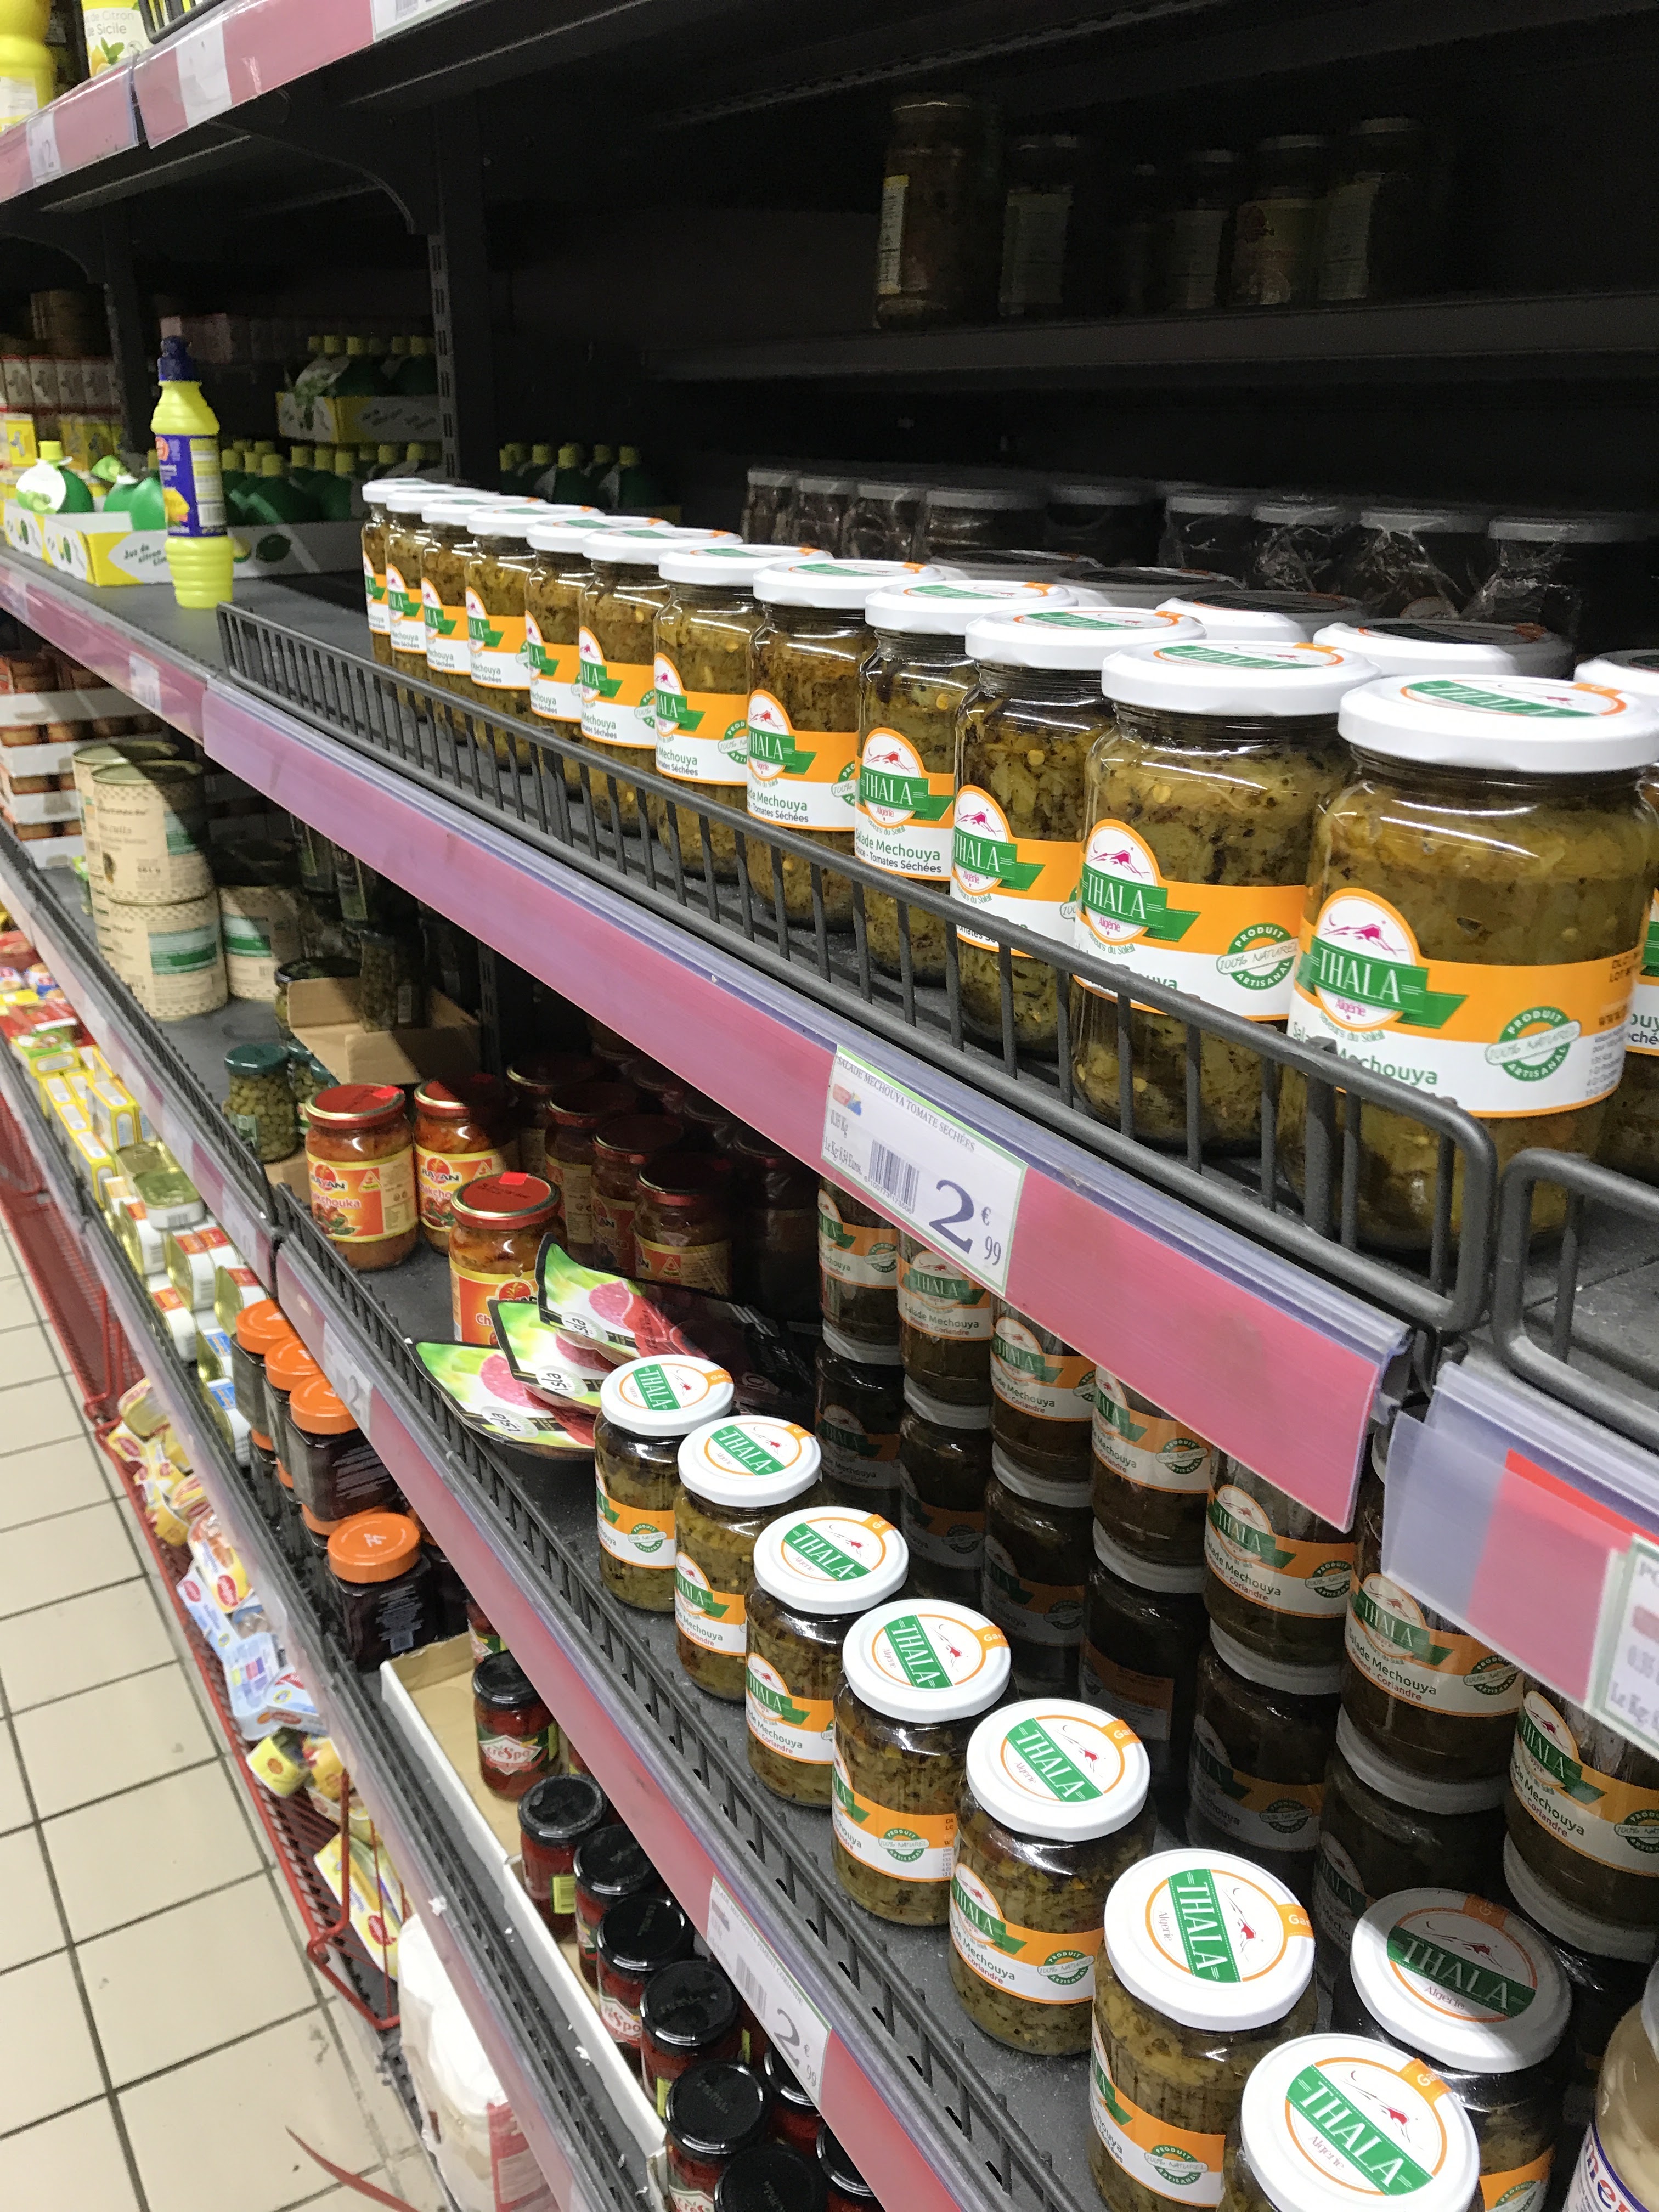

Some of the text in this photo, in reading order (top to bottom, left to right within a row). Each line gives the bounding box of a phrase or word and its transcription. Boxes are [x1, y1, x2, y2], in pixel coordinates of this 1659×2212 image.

[97, 23, 127, 35] Sicile
[102, 10, 134, 21] Citron
[659, 748, 698, 766] Mechouya
[757, 791, 808, 812] Mechouya
[865, 772, 913, 805] THALA
[775, 808, 809, 823] Séchées
[870, 852, 941, 873] Tomates Séchées
[876, 838, 940, 862] Mechouya
[955, 833, 1000, 873] THALA
[1087, 872, 1147, 920] THALA
[1098, 916, 1121, 932] Algérie
[1234, 927, 1284, 949] PRODUIT
[1220, 955, 1248, 970] 100%
[1236, 960, 1290, 988] ARTISANAL
[1319, 947, 1401, 1003] THALA
[1507, 1009, 1562, 1035] PRODUIT
[1508, 1048, 1567, 1079] ARTISANAL
[837, 1056, 864, 1080] SALADE
[864, 1073, 906, 1107] MECHOUYA
[906, 1098, 938, 1128] TOMATE
[421, 1168, 459, 1181] RAYAN
[929, 1179, 1002, 1266] 2 € 99
[917, 1274, 958, 1296] THALA
[929, 1314, 979, 1329] Mechouya
[934, 1325, 969, 1337] Coriandre
[638, 1369, 673, 1408] THALA
[1006, 1383, 1056, 1408] Mechouya
[1011, 1395, 1046, 1414] Coriandre
[718, 1430, 769, 1474] THALA
[1218, 1507, 1261, 1553] THALA
[791, 1527, 855, 1579] THALA
[1224, 1560, 1282, 1596] Mechouya
[1229, 1576, 1268, 1601] Coriandre
[683, 1616, 724, 1642] Mechouya
[686, 1627, 715, 1647] Coriandre
[1364, 1599, 1413, 1647] THALA
[892, 1623, 941, 1685] THALA
[1372, 1656, 1437, 1696] Mechouya
[1377, 1673, 1423, 1702] Coriandre
[749, 1678, 782, 1713] THALA
[757, 1720, 803, 1750] Mechouya
[761, 1733, 794, 1755] Coriandre
[1521, 1716, 1565, 1780] THALA
[1015, 1729, 1085, 1799] THALA
[1523, 1781, 1585, 1836] Mechouya
[1526, 1802, 1568, 1838] Coriandre
[887, 1829, 916, 1838] PRODUIT
[889, 1849, 923, 1863] ARTISANAL
[955, 1884, 995, 1937] THALA
[1176, 1882, 1228, 1971] THALA
[962, 1940, 1016, 1982] Mechouya
[967, 1955, 1005, 1985] Coriandre
[1048, 1951, 1082, 1963] PRODUIT
[1060, 1957, 1093, 1971] NATUREL
[1049, 1967, 1088, 1986] ARTISANAL
[1403, 1937, 1508, 2010] THALA
[774, 2008, 800, 2068] 2
[806, 2064, 817, 2087] 99
[1300, 2081, 1404, 2188] THALA
[1155, 2146, 1192, 2161] PRODUIT
[1156, 2166, 1199, 2185] ARTISANAL
